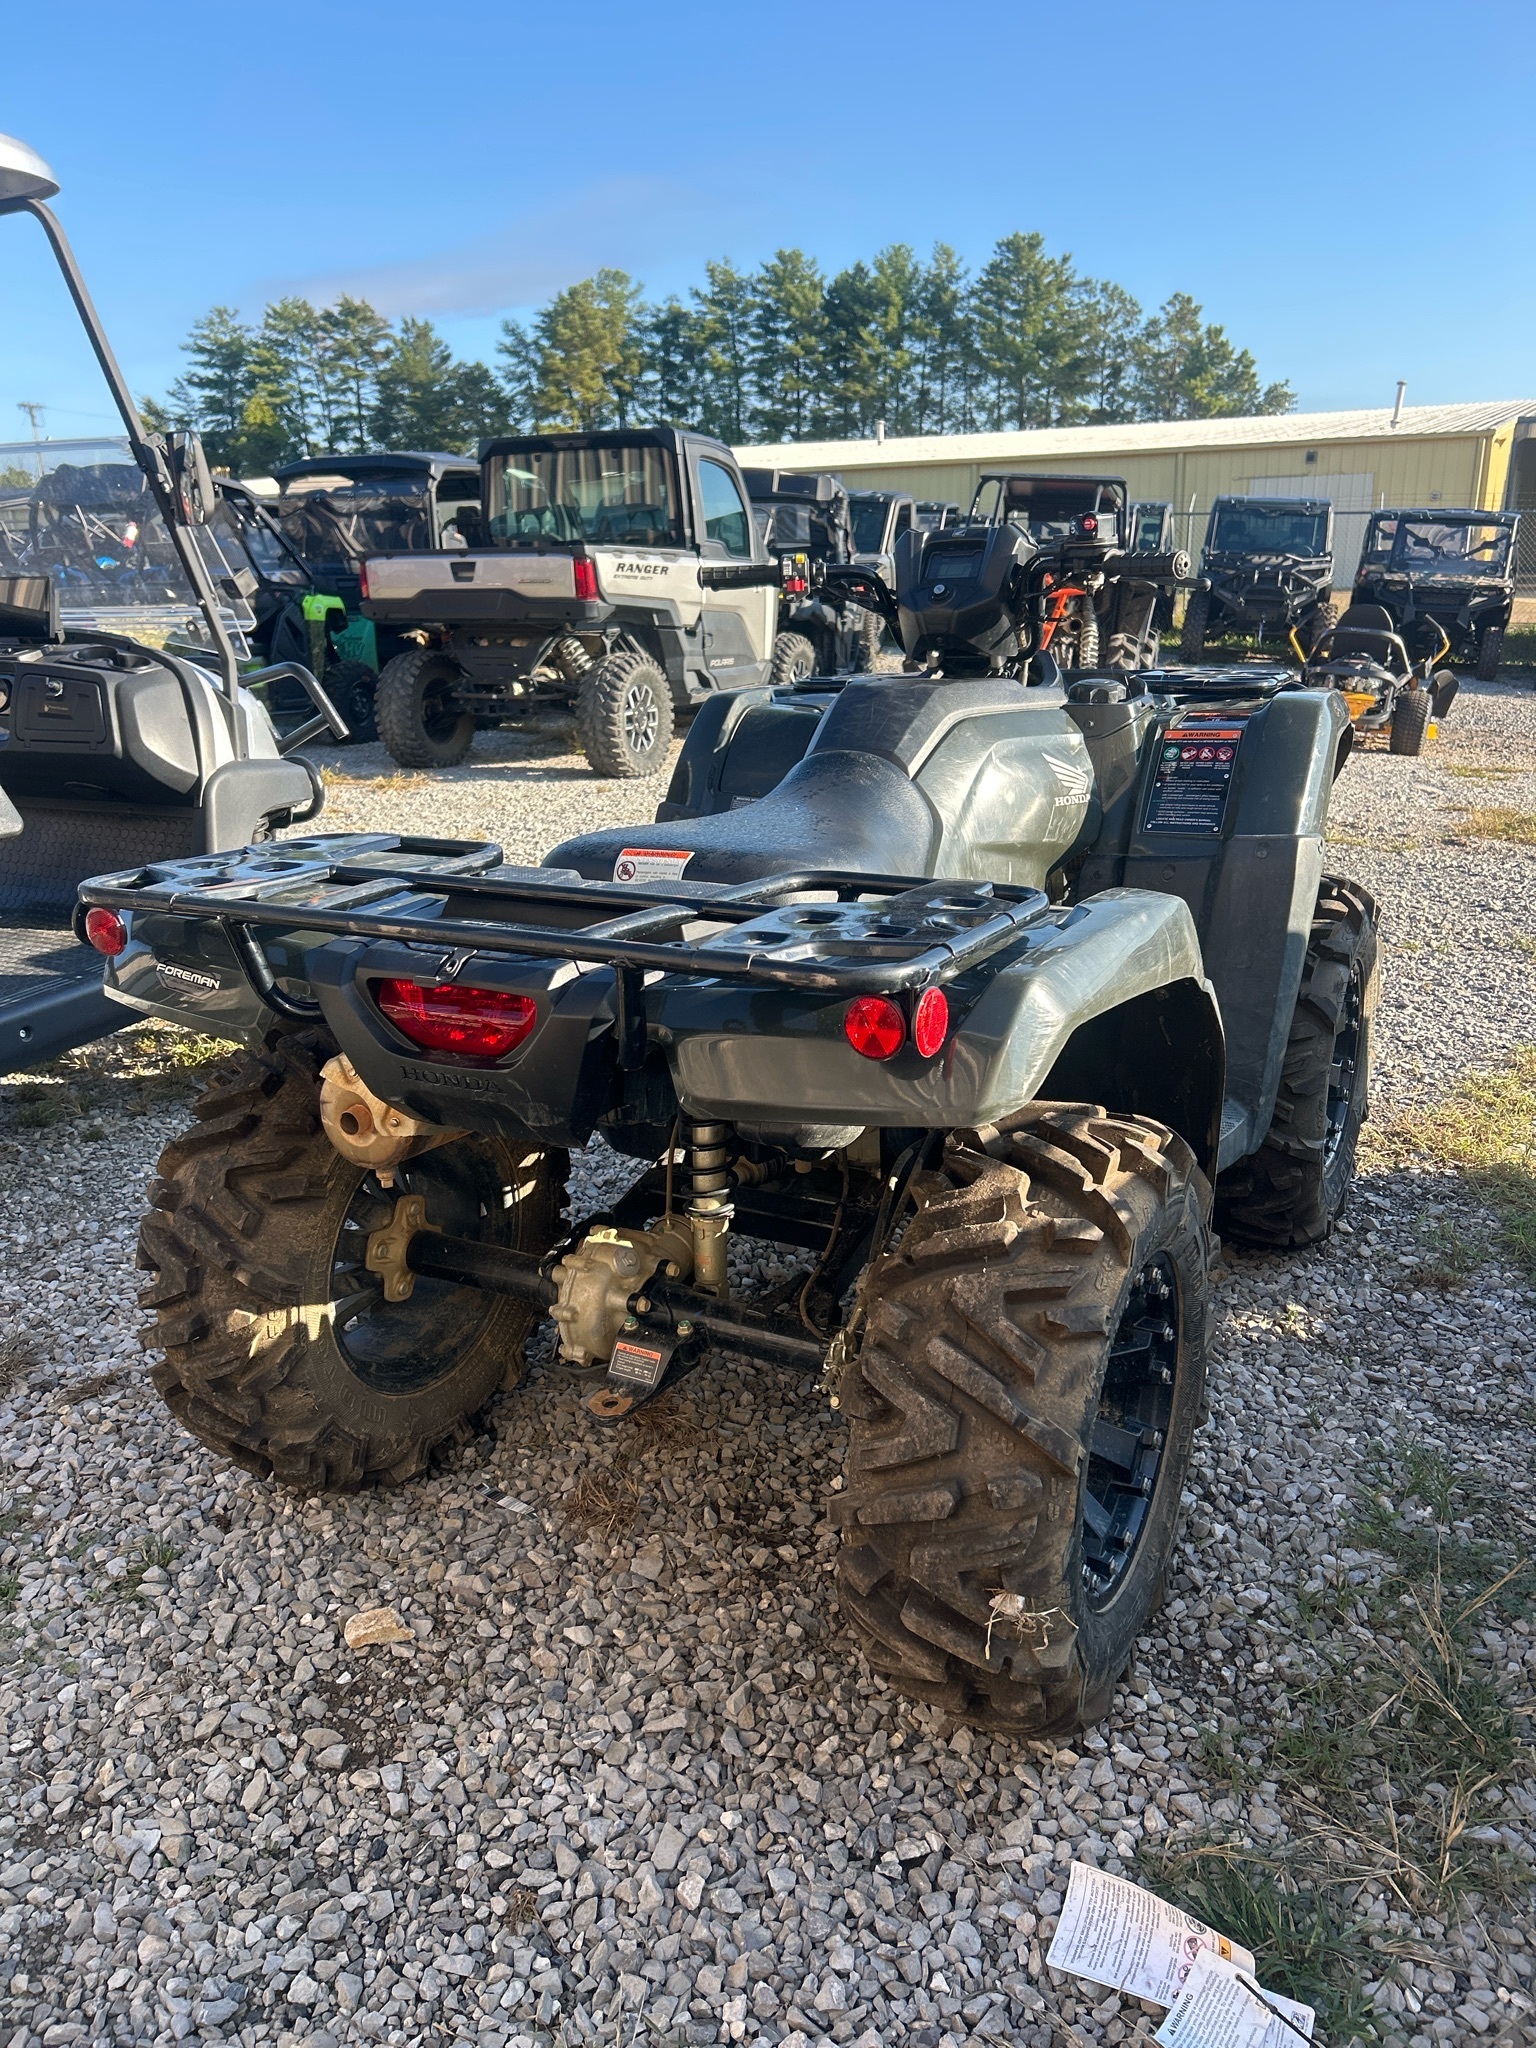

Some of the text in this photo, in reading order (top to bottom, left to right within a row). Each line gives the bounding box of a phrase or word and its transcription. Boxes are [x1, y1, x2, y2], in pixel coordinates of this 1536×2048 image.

[616, 563, 669, 575] RANGER
[710, 658, 735, 667] POLARIS
[156, 963, 220, 989] FOREMAN
[400, 1066, 507, 1096] HONDA
[1172, 1993, 1194, 2029] WARNING
